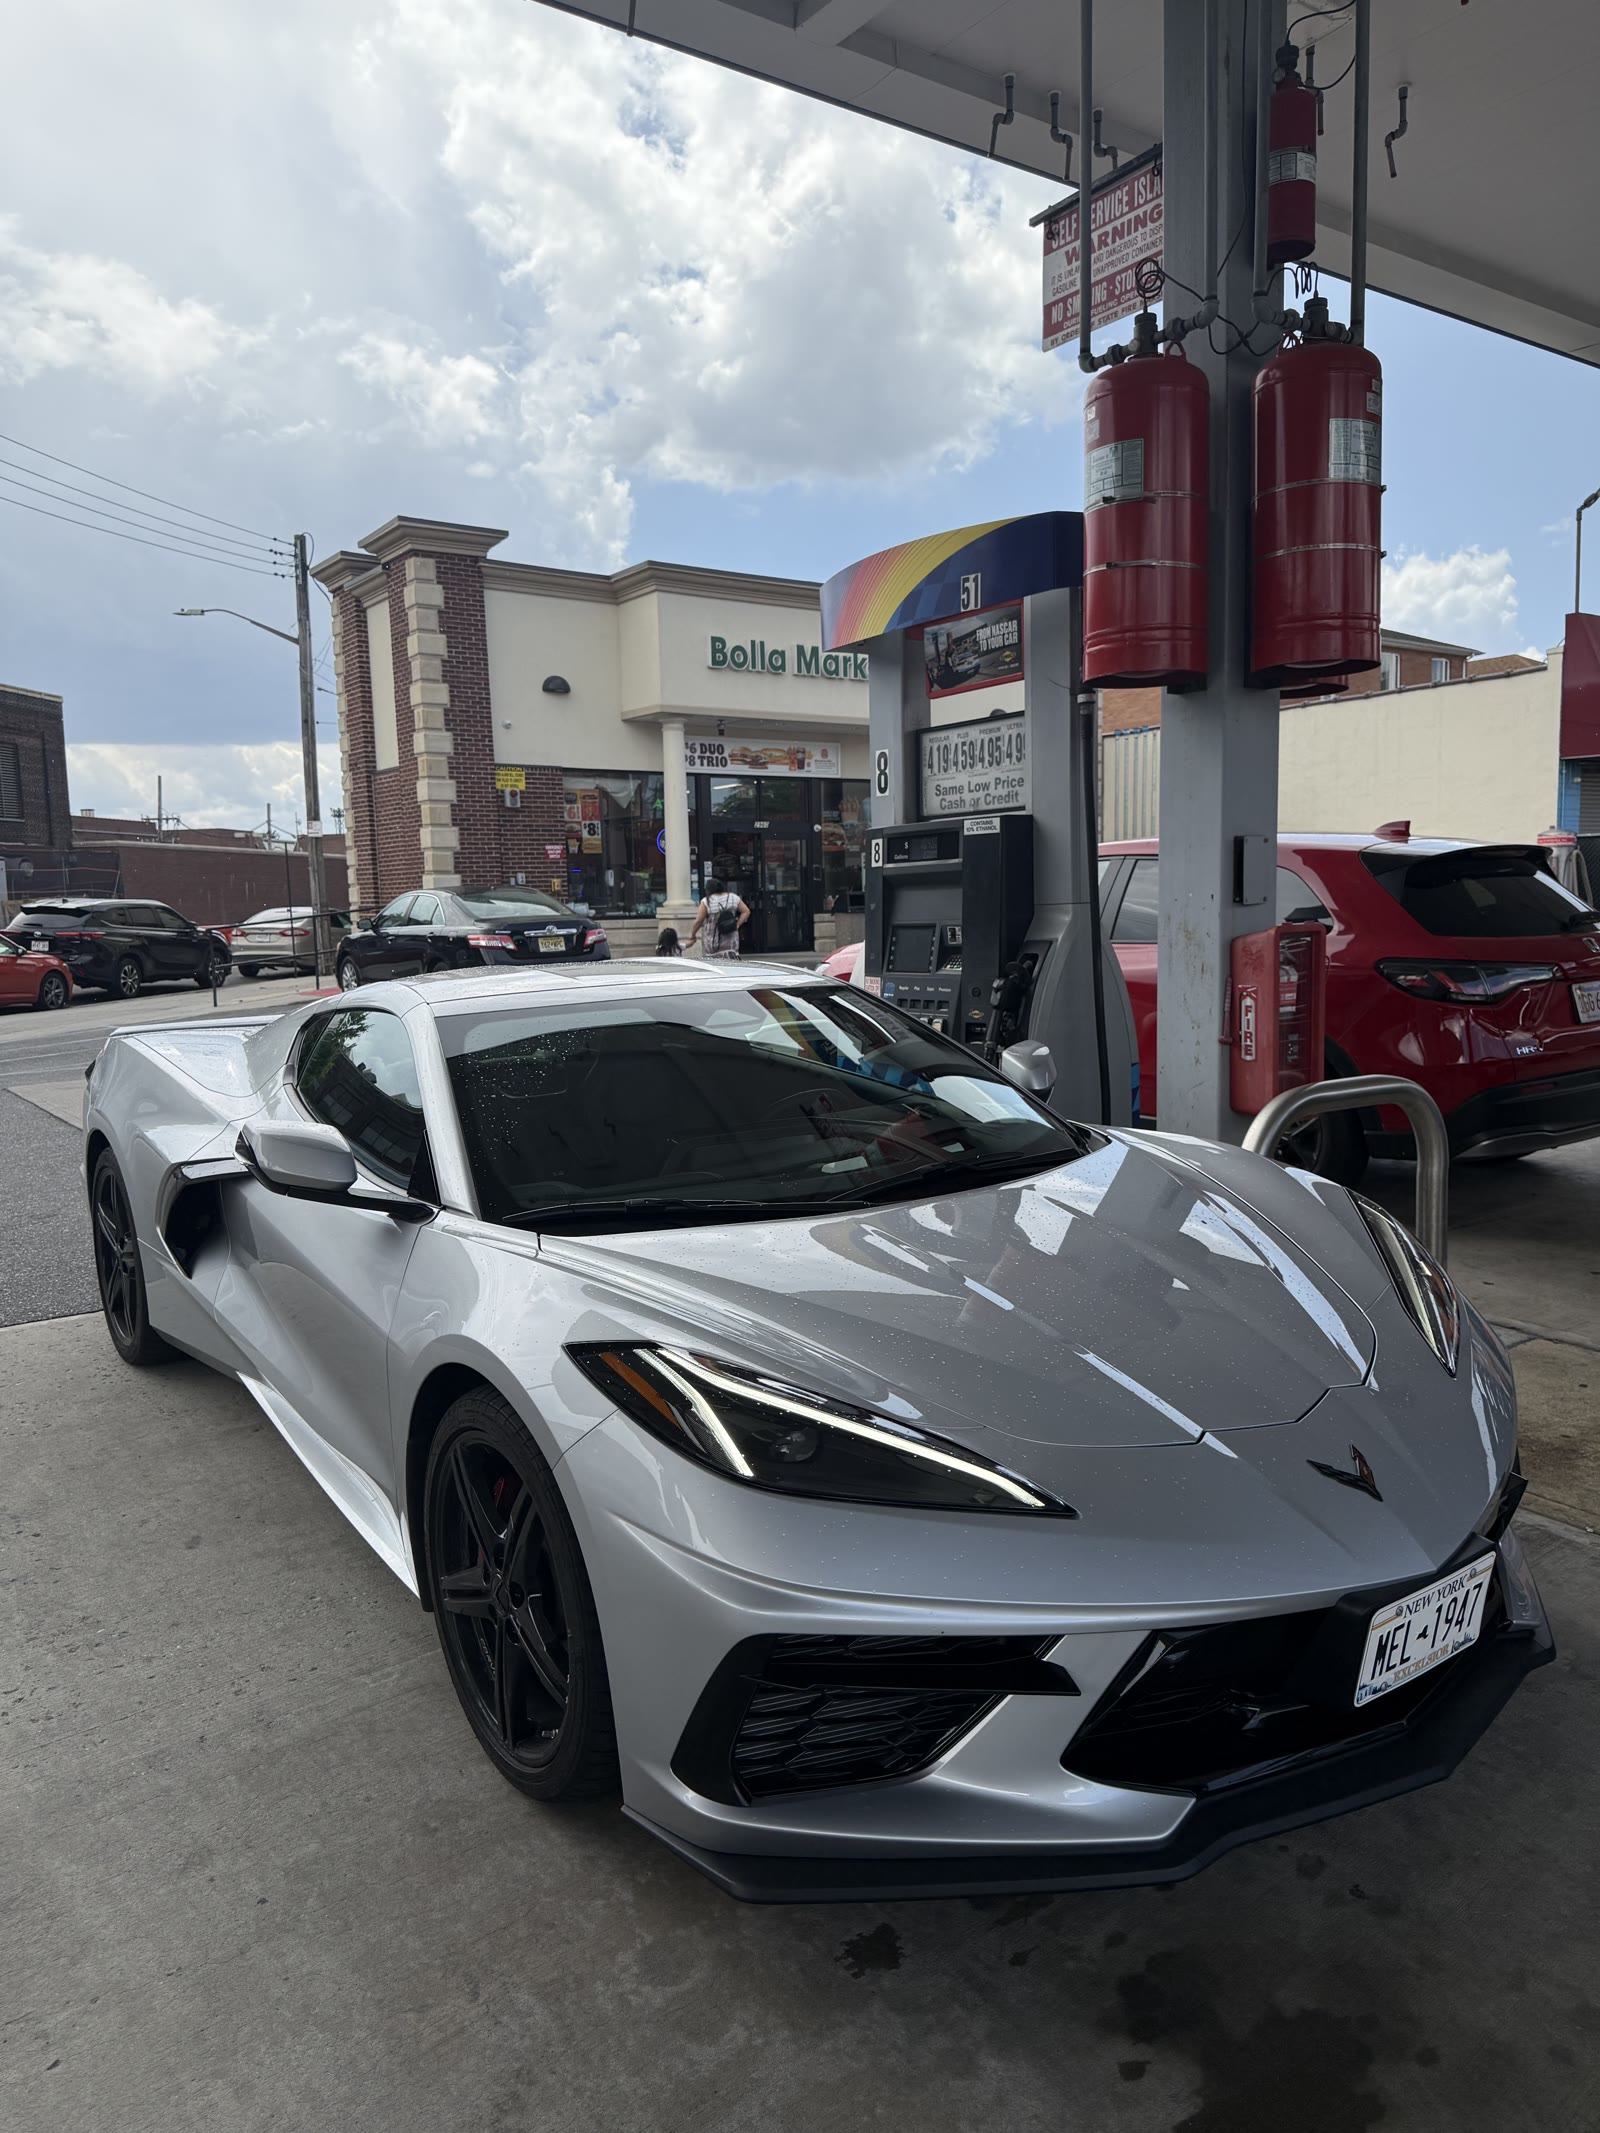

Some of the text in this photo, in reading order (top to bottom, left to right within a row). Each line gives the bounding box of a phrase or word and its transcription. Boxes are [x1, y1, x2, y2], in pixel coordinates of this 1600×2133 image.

[1051, 173, 1163, 250] SELF ERVICE ISLA
[1051, 274, 1057, 285] IT
[1057, 272, 1063, 283] IS
[1064, 265, 1080, 281] UNLA
[1092, 255, 1104, 266] AND
[1105, 235, 1139, 260] DANGEROUS
[1140, 231, 1148, 243] TO
[1052, 278, 1078, 297] GASOLINE
[1092, 253, 1130, 279] UNAPPROVED
[1051, 302, 1064, 325] NO
[1067, 282, 1107, 318] SMING
[1063, 317, 1080, 329] DURI
[1091, 299, 1118, 316] FUELING
[1120, 290, 1139, 303] OPER
[1050, 336, 1059, 347] BY
[1061, 328, 1080, 341] ORDE
[1097, 310, 1119, 326] STATE
[1121, 302, 1137, 315] FIRE
[961, 574, 980, 611] 51
[976, 619, 1018, 642] FROM NASCAR
[980, 632, 1019, 652] TO YOUR CAR
[709, 635, 869, 680] Bolla Mark
[699, 742, 725, 756] DUO
[928, 722, 1024, 744] REGULAR PLUS PREMIUM ULTRA
[1006, 732, 1026, 766] 4.9
[698, 755, 728, 768] TRIO
[877, 751, 889, 795] 8
[935, 783, 965, 797] Same
[968, 780, 991, 794] Low
[994, 776, 1025, 791] Price
[940, 790, 1020, 811] Cash or Credit
[873, 842, 881, 864] 8
[1245, 1005, 1253, 1057] FIRE
[1404, 1573, 1468, 1618] NEW YORK
[1371, 1581, 1484, 1681] MEL 1947
[479, 1637, 496, 1674] CORV
[1392, 1643, 1450, 1684] EXCELSIOR
